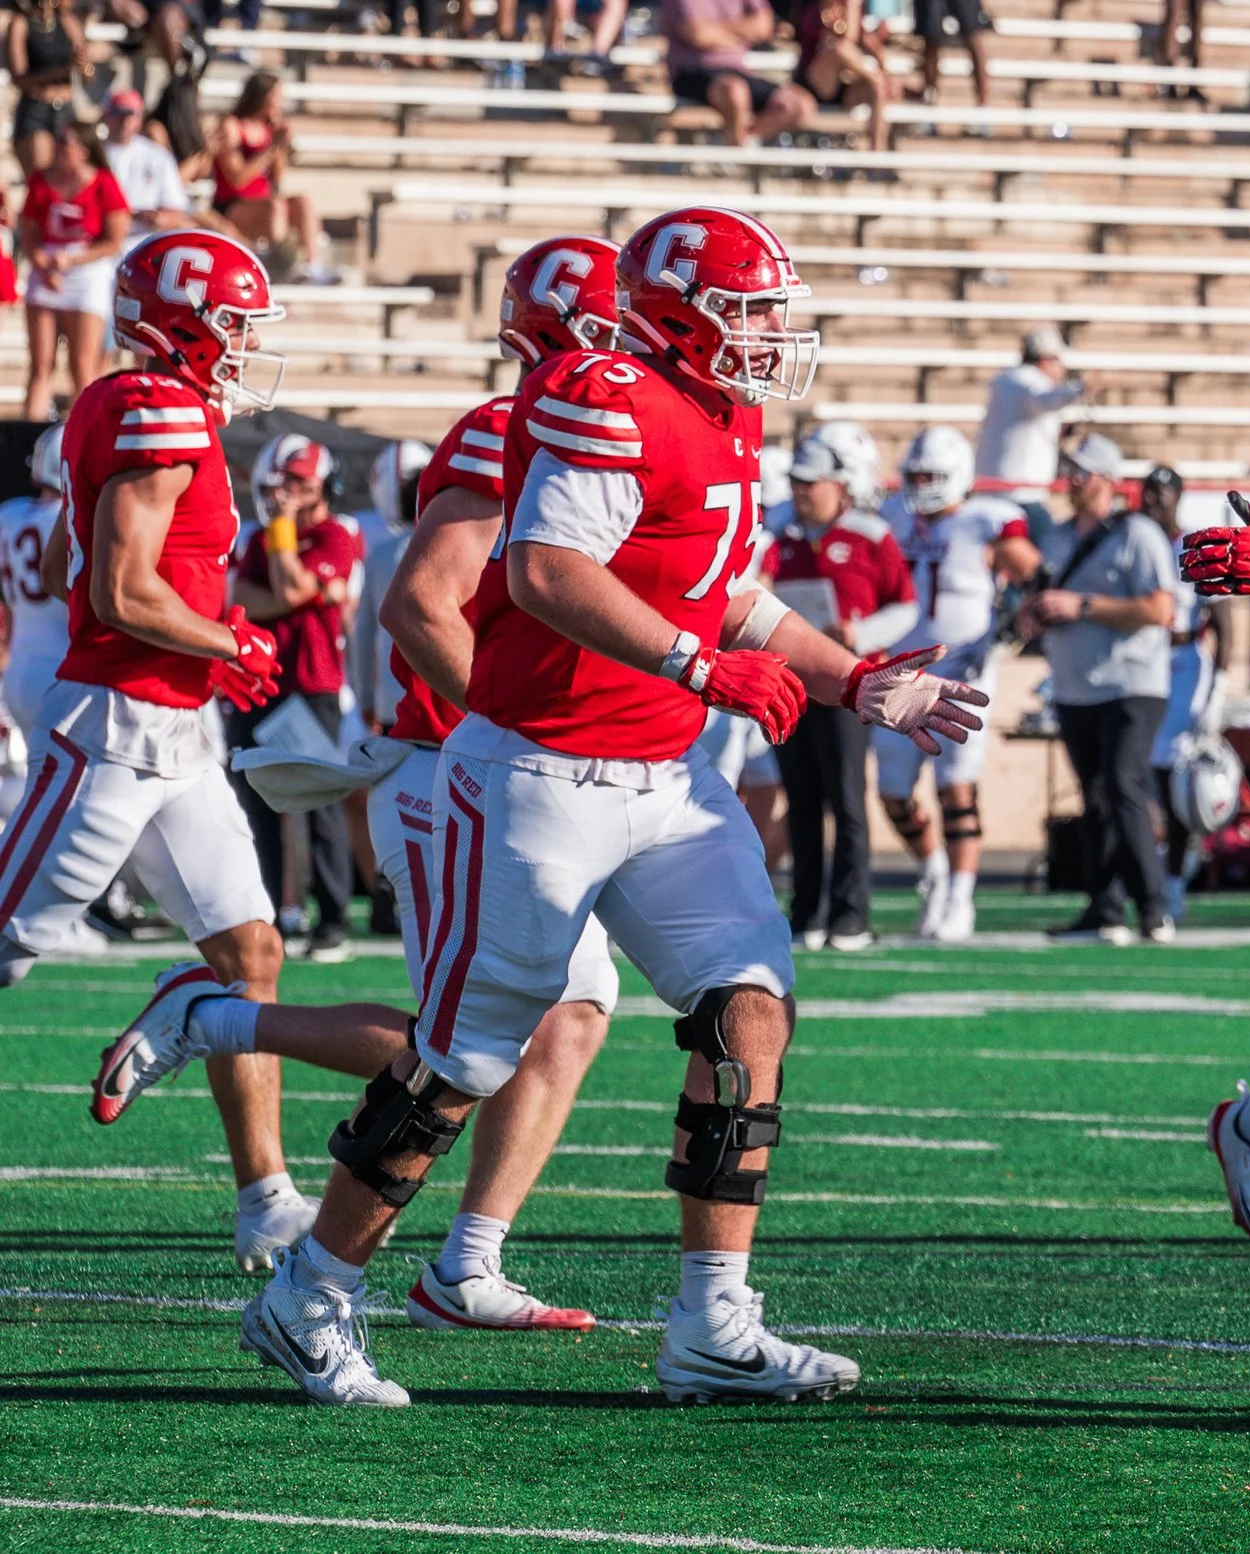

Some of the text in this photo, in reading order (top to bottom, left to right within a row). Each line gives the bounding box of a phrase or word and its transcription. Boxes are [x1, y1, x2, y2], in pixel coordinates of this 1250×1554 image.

[157, 246, 214, 304] C
[530, 248, 594, 307] C
[645, 222, 708, 287] C
[573, 352, 646, 385] 75
[733, 437, 744, 457] C
[452, 762, 482, 797] BIG RED
